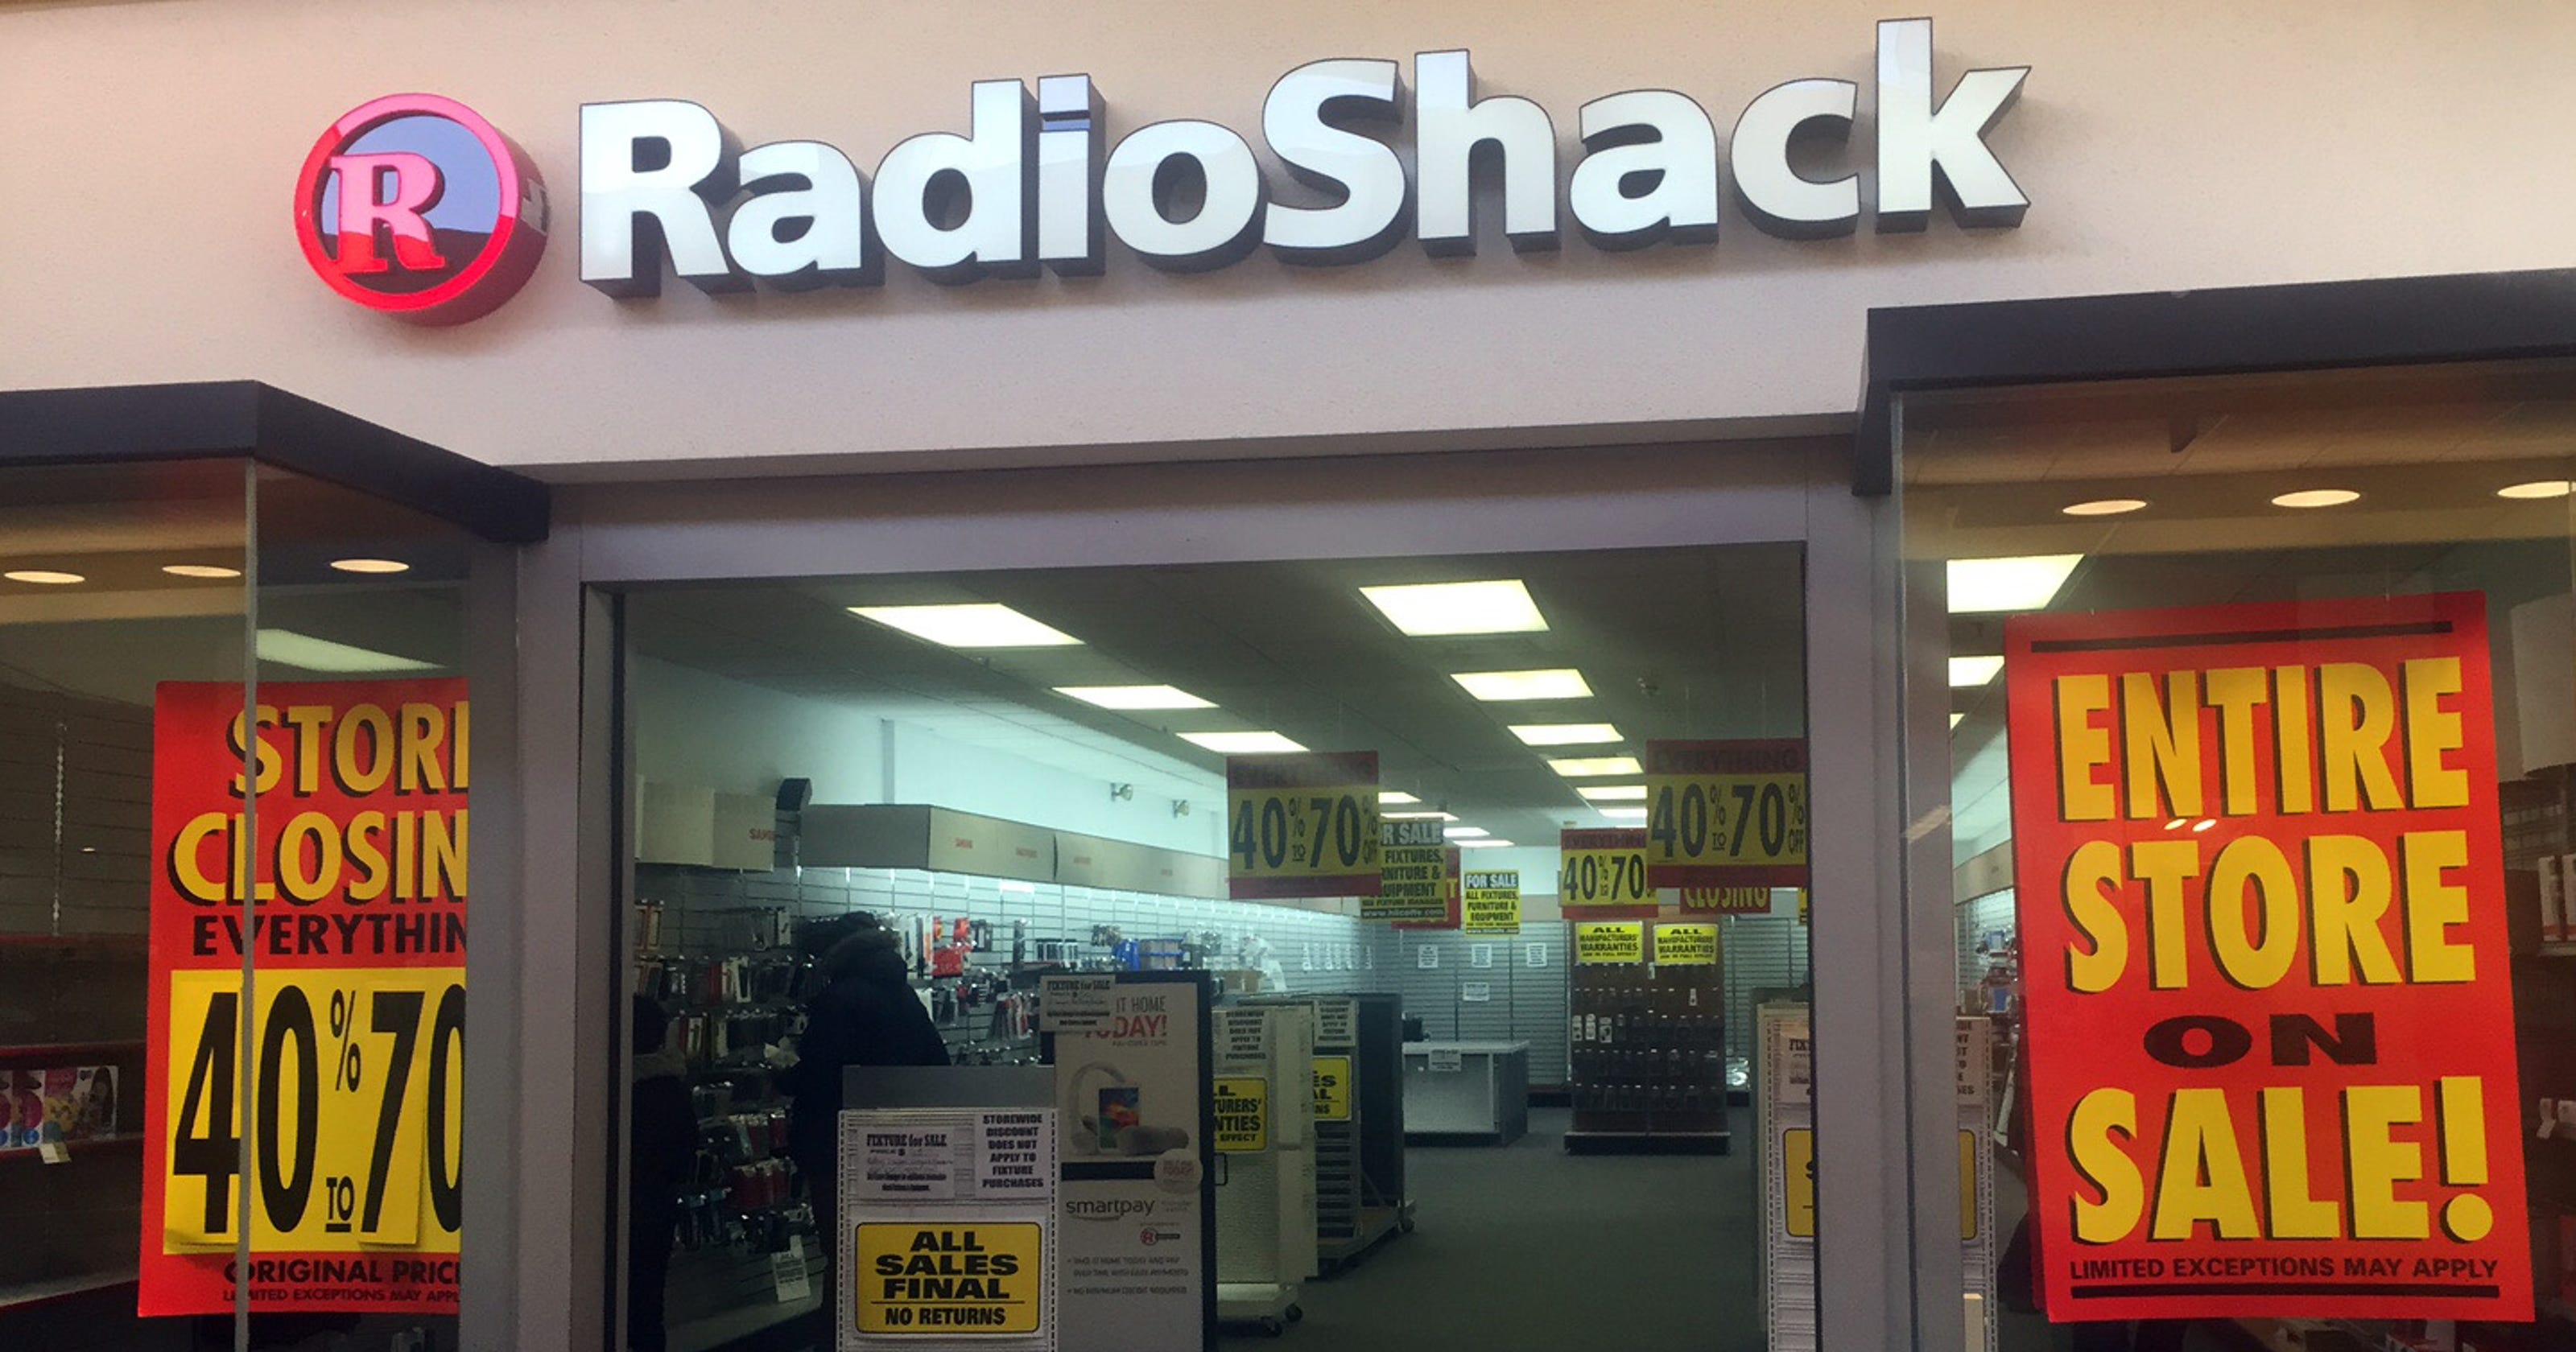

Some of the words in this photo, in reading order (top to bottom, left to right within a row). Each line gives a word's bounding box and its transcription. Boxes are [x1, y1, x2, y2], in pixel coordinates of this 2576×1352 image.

[580, 16, 2033, 286] RadioShack
[330, 151, 446, 275] R
[2052, 657, 2470, 822] ENTIRE
[1399, 822, 1443, 844] SALE
[1466, 876, 1486, 887] FOR
[1490, 875, 1517, 887] SALE
[1611, 854, 1645, 900] 70
[2060, 830, 2475, 993] STORE
[1116, 996, 1126, 1013] IT
[1130, 995, 1166, 1012] HOME
[2143, 1013, 2377, 1068] ON
[983, 1114, 1042, 1124] STOREWIDE
[867, 1134, 907, 1147] FIXTURE
[924, 1134, 947, 1147] SALE
[986, 1127, 1038, 1137] DISCOUNT
[989, 1140, 1014, 1149] DOES
[1017, 1140, 1037, 1149] NOT
[990, 1153, 1020, 1163] APPLY
[1022, 1153, 1037, 1163] TO
[2066, 1076, 2493, 1243] SALE!
[993, 1165, 1034, 1175] FIXTURE
[982, 1178, 1044, 1189] PURCHASES
[325, 1176, 355, 1231] TO
[1066, 1199, 1155, 1216] smartpay
[910, 1231, 985, 1252] ALL
[224, 1259, 382, 1285] ORIGINAL
[876, 1254, 1019, 1276] SALES
[2070, 1259, 2165, 1280] LIMITED
[2173, 1256, 2334, 1278] EXCEPTIONS
[2343, 1257, 2403, 1278] MAY
[2412, 1258, 2498, 1279] APPLY
[292, 1288, 386, 1301] EXCEPTIONS
[390, 1289, 422, 1301] MAY
[883, 1278, 1009, 1300] FINAL
[885, 1308, 912, 1325] NO
[919, 1308, 1005, 1326] RETURNS
